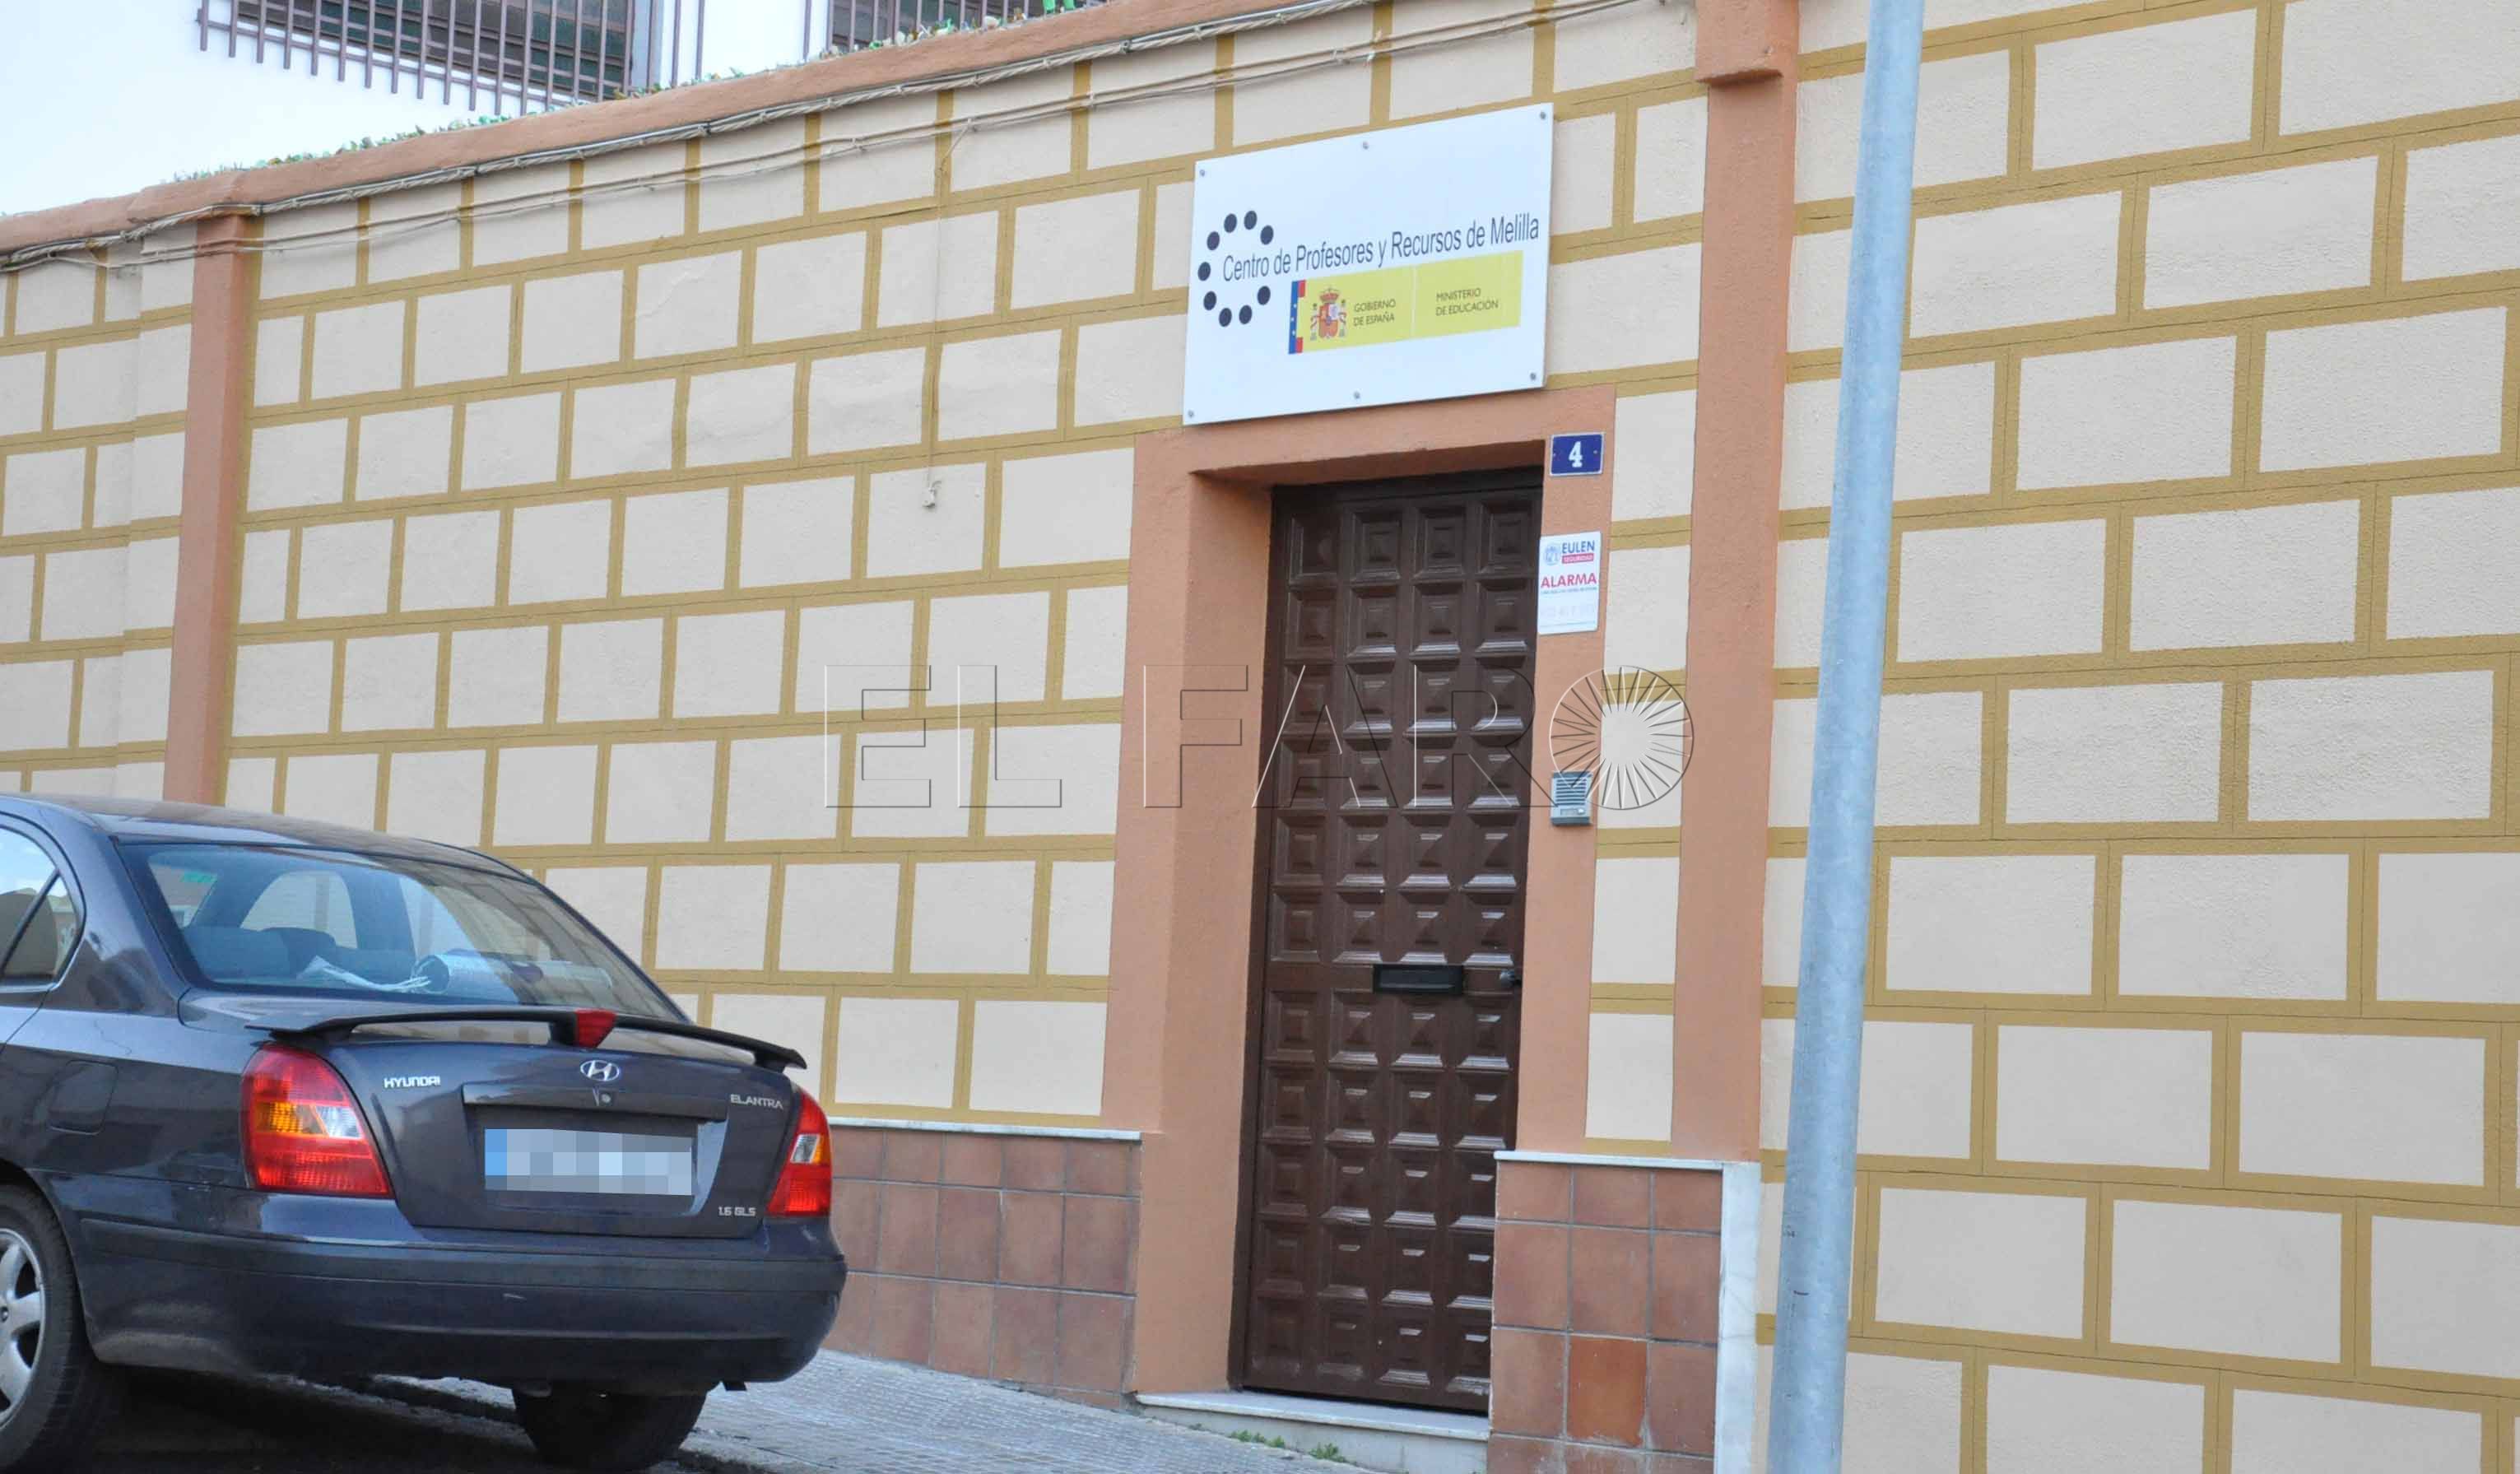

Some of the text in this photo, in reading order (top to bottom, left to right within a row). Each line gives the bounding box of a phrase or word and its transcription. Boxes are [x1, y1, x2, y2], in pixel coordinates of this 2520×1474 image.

[1223, 212, 1540, 281] Centro de Profesores y Recursos de Melilla
[1436, 288, 1481, 302] MINISTERIO
[1354, 299, 1396, 313] GOBIERNO
[1435, 306, 1447, 316] DE
[1353, 311, 1395, 327] DE ESPAÑA
[1569, 441, 1583, 468] 4
[1562, 541, 1595, 554] EULEN
[1541, 573, 1597, 588] ALARMA
[384, 1075, 440, 1088] HYUNDAI
[730, 1094, 783, 1109] ELANTRA
[718, 1207, 756, 1216] 1.6 GLS
